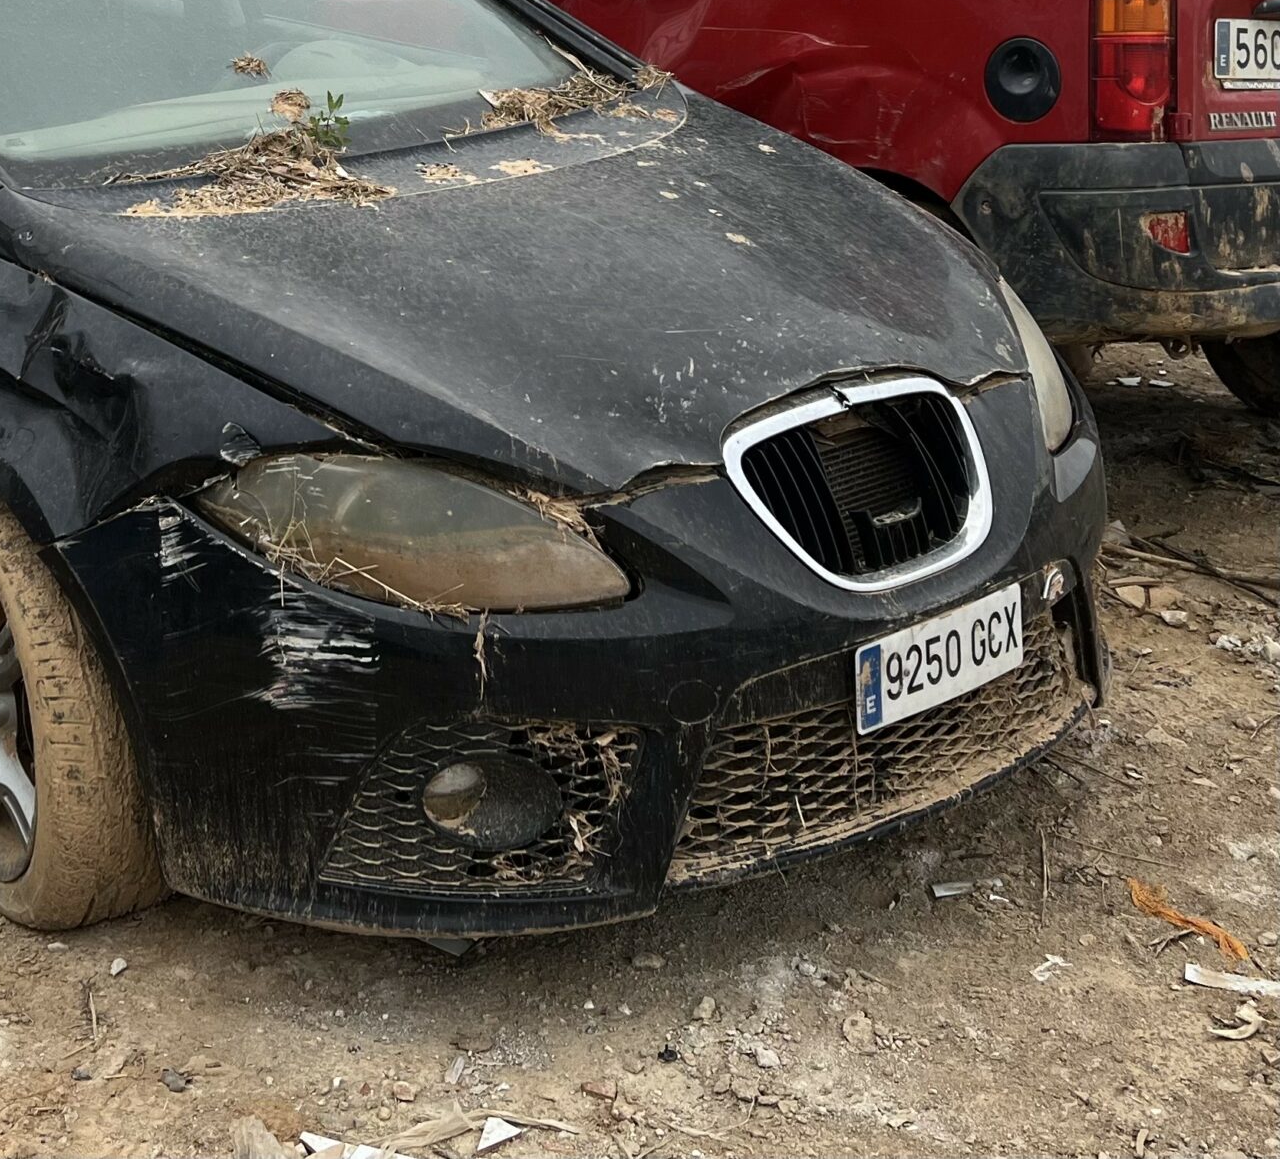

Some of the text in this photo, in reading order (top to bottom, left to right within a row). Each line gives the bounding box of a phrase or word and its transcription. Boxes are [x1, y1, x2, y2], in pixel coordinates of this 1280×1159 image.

[1220, 54, 1227, 67] E
[1209, 111, 1277, 129] RENAULT
[866, 601, 1019, 714] E 9250 GCX
